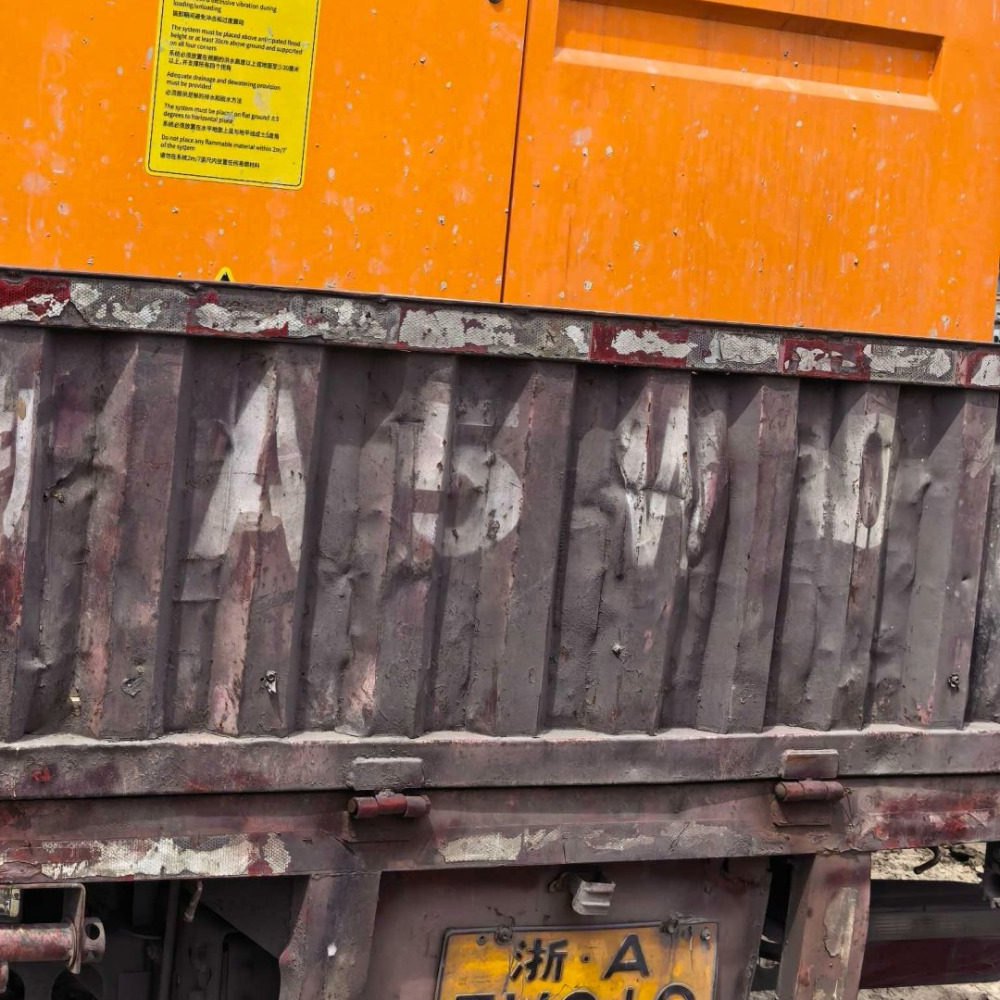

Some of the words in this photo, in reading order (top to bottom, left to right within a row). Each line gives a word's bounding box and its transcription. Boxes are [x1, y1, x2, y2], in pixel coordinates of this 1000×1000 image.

[235, 1, 258, 9] vibration
[259, 4, 276, 13] during
[182, 26, 200, 34] system
[223, 31, 240, 39] placed
[170, 32, 187, 40] height
[246, 42, 264, 50] ground
[276, 45, 302, 55] supported
[196, 43, 217, 51] corners
[166, 71, 191, 80] Adequate
[192, 74, 215, 83] drainage
[227, 79, 256, 89] dewatering
[256, 82, 280, 91] provision
[188, 81, 211, 90] provided
[163, 110, 183, 119] degrees
[191, 113, 217, 122] horizontal
[175, 104, 193, 112] system
[251, 113, 269, 121] ground
[176, 144, 195, 152] system
[205, 138, 232, 147] flammable
